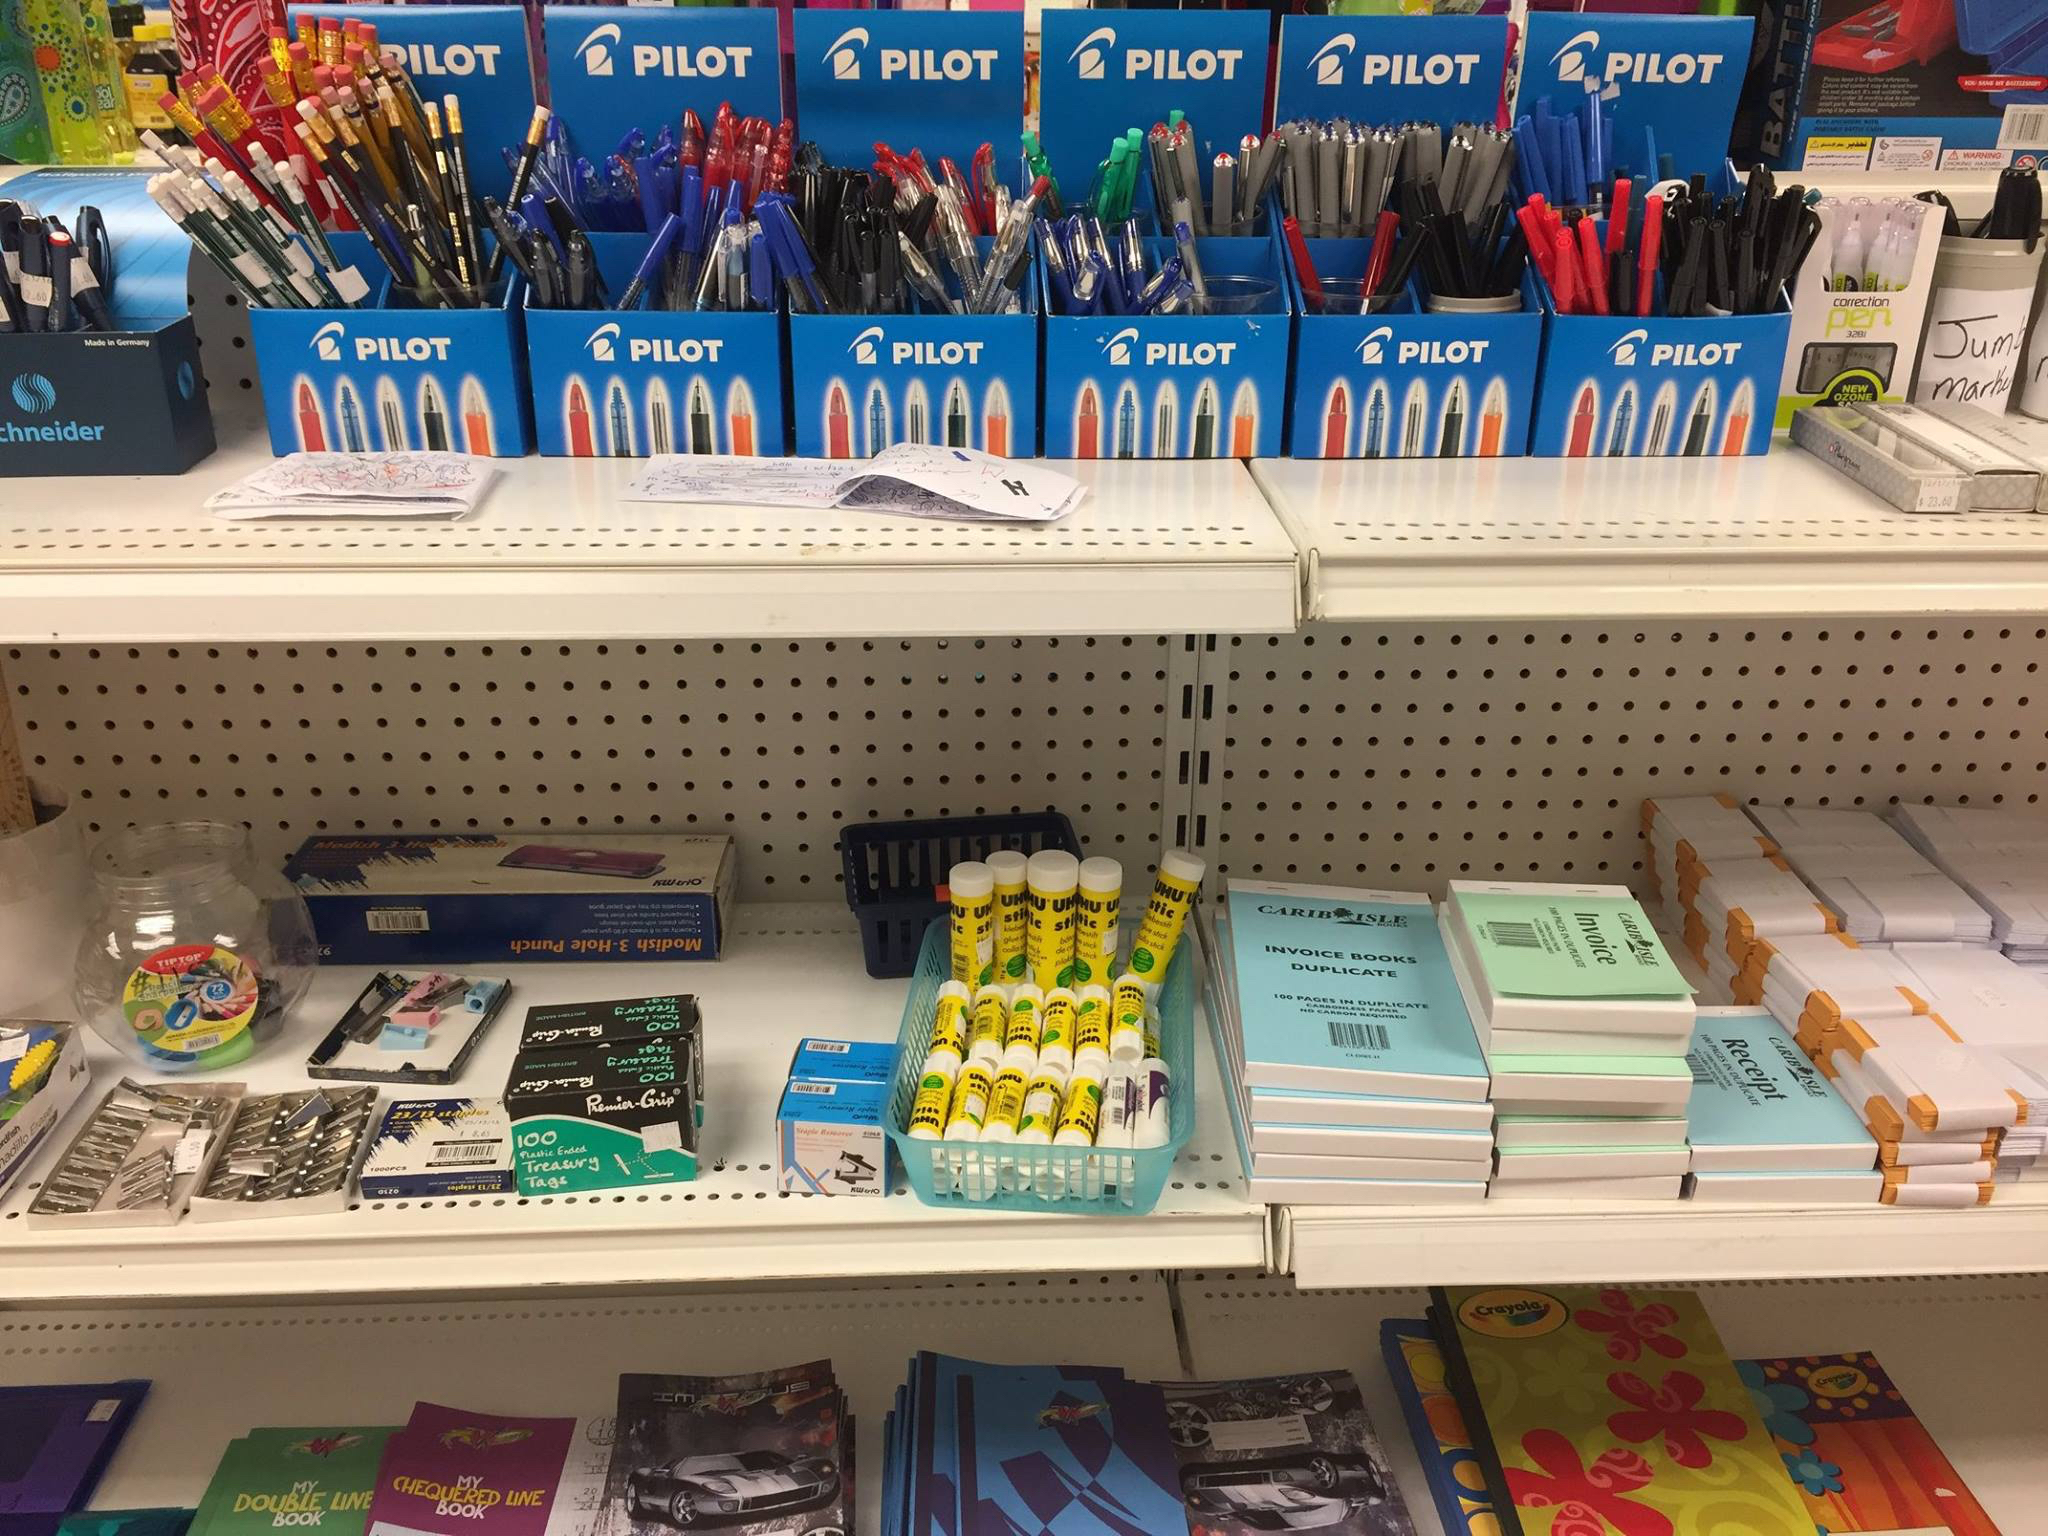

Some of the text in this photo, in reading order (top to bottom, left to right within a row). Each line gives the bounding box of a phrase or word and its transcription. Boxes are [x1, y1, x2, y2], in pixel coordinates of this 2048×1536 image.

[633, 45, 752, 77] PILOT
[881, 50, 998, 80] PILOT
[1126, 50, 1243, 80] PILOT
[1364, 54, 1480, 84] PILOT
[1605, 53, 1723, 84] PILOT
[1833, 296, 1890, 307] correction
[1825, 308, 1893, 338] pen
[84, 339, 150, 348] Made in Germany
[355, 338, 450, 361] PILOT
[630, 339, 723, 362] PILOT
[1398, 341, 1489, 364] PILOT
[893, 342, 983, 364] PILOT
[1147, 343, 1236, 365] PILOT
[1651, 343, 1741, 366] PILOT
[1834, 393, 1873, 401] OZONE
[1842, 384, 1868, 392] NEW
[1001, 892, 1025, 907] UH
[1149, 900, 1175, 918] stic
[1257, 904, 1408, 924] CARIB ISLE
[510, 939, 702, 953] Modish 3-Hole Punch
[1574, 912, 1617, 966] Invoice
[1618, 912, 1660, 968] CARIB ISLE
[1265, 945, 1418, 964] INVOICE BOOKS
[1291, 962, 1398, 978] DUPLICATE
[614, 1005, 680, 1016] Treasury
[1297, 995, 1336, 1004] PAGES
[1357, 1000, 1429, 1009] DUPLICATE
[646, 1022, 681, 1032] 100
[638, 1045, 674, 1054] Tags
[607, 1055, 675, 1067] Treasury
[1722, 1038, 1789, 1101] Receipt
[1768, 1036, 1828, 1099] CARIB ISLE
[639, 1072, 675, 1083] 100
[1729, 1068, 1762, 1107] DUPLICATE
[586, 1088, 675, 1115] Premier-Grip
[517, 1131, 557, 1148] 100
[520, 1145, 588, 1159] Plastic Ended
[521, 1156, 600, 1174] Treasury
[523, 1177, 568, 1188] Tags
[1476, 1299, 1543, 1316] Crayola
[293, 1481, 319, 1493] MY
[456, 1475, 484, 1488] MY
[392, 1476, 547, 1507] CHEQUERED LINE
[232, 1491, 374, 1513] DOUBLE LINE
[435, 1502, 491, 1520] BOOK
[271, 1510, 325, 1527] BOOK
